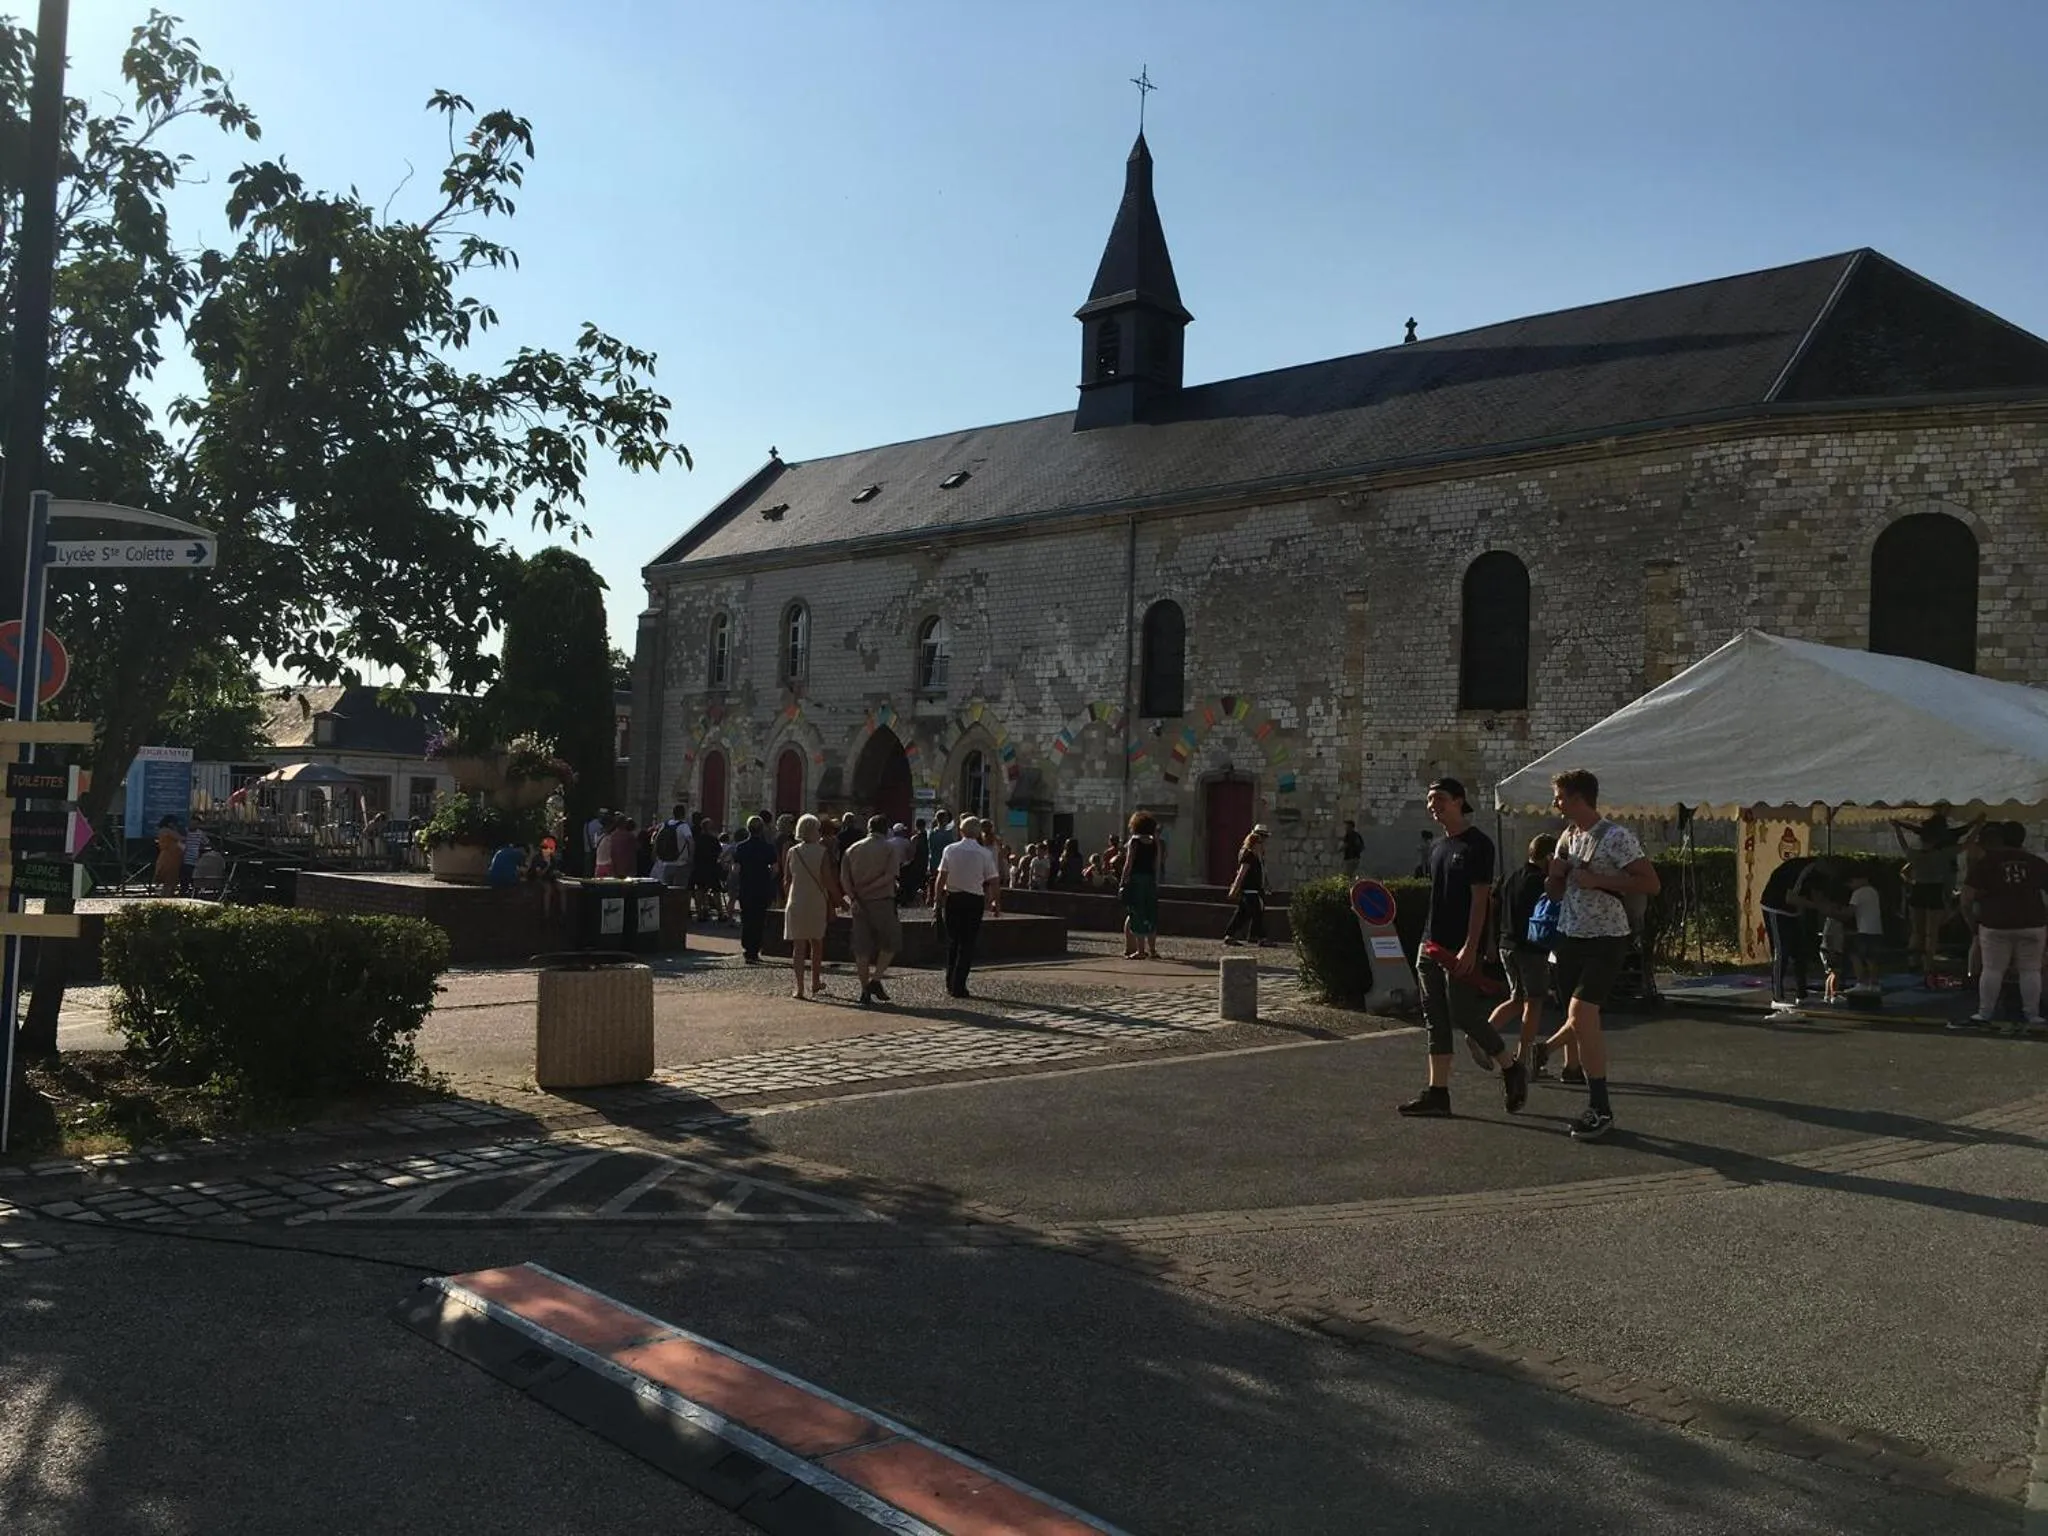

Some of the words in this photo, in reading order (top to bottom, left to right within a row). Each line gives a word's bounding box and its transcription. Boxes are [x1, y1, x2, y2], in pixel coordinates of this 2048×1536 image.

[58, 545, 95, 565] Lycée
[126, 546, 175, 561] Colette
[12, 773, 66, 788] TOILETTES
